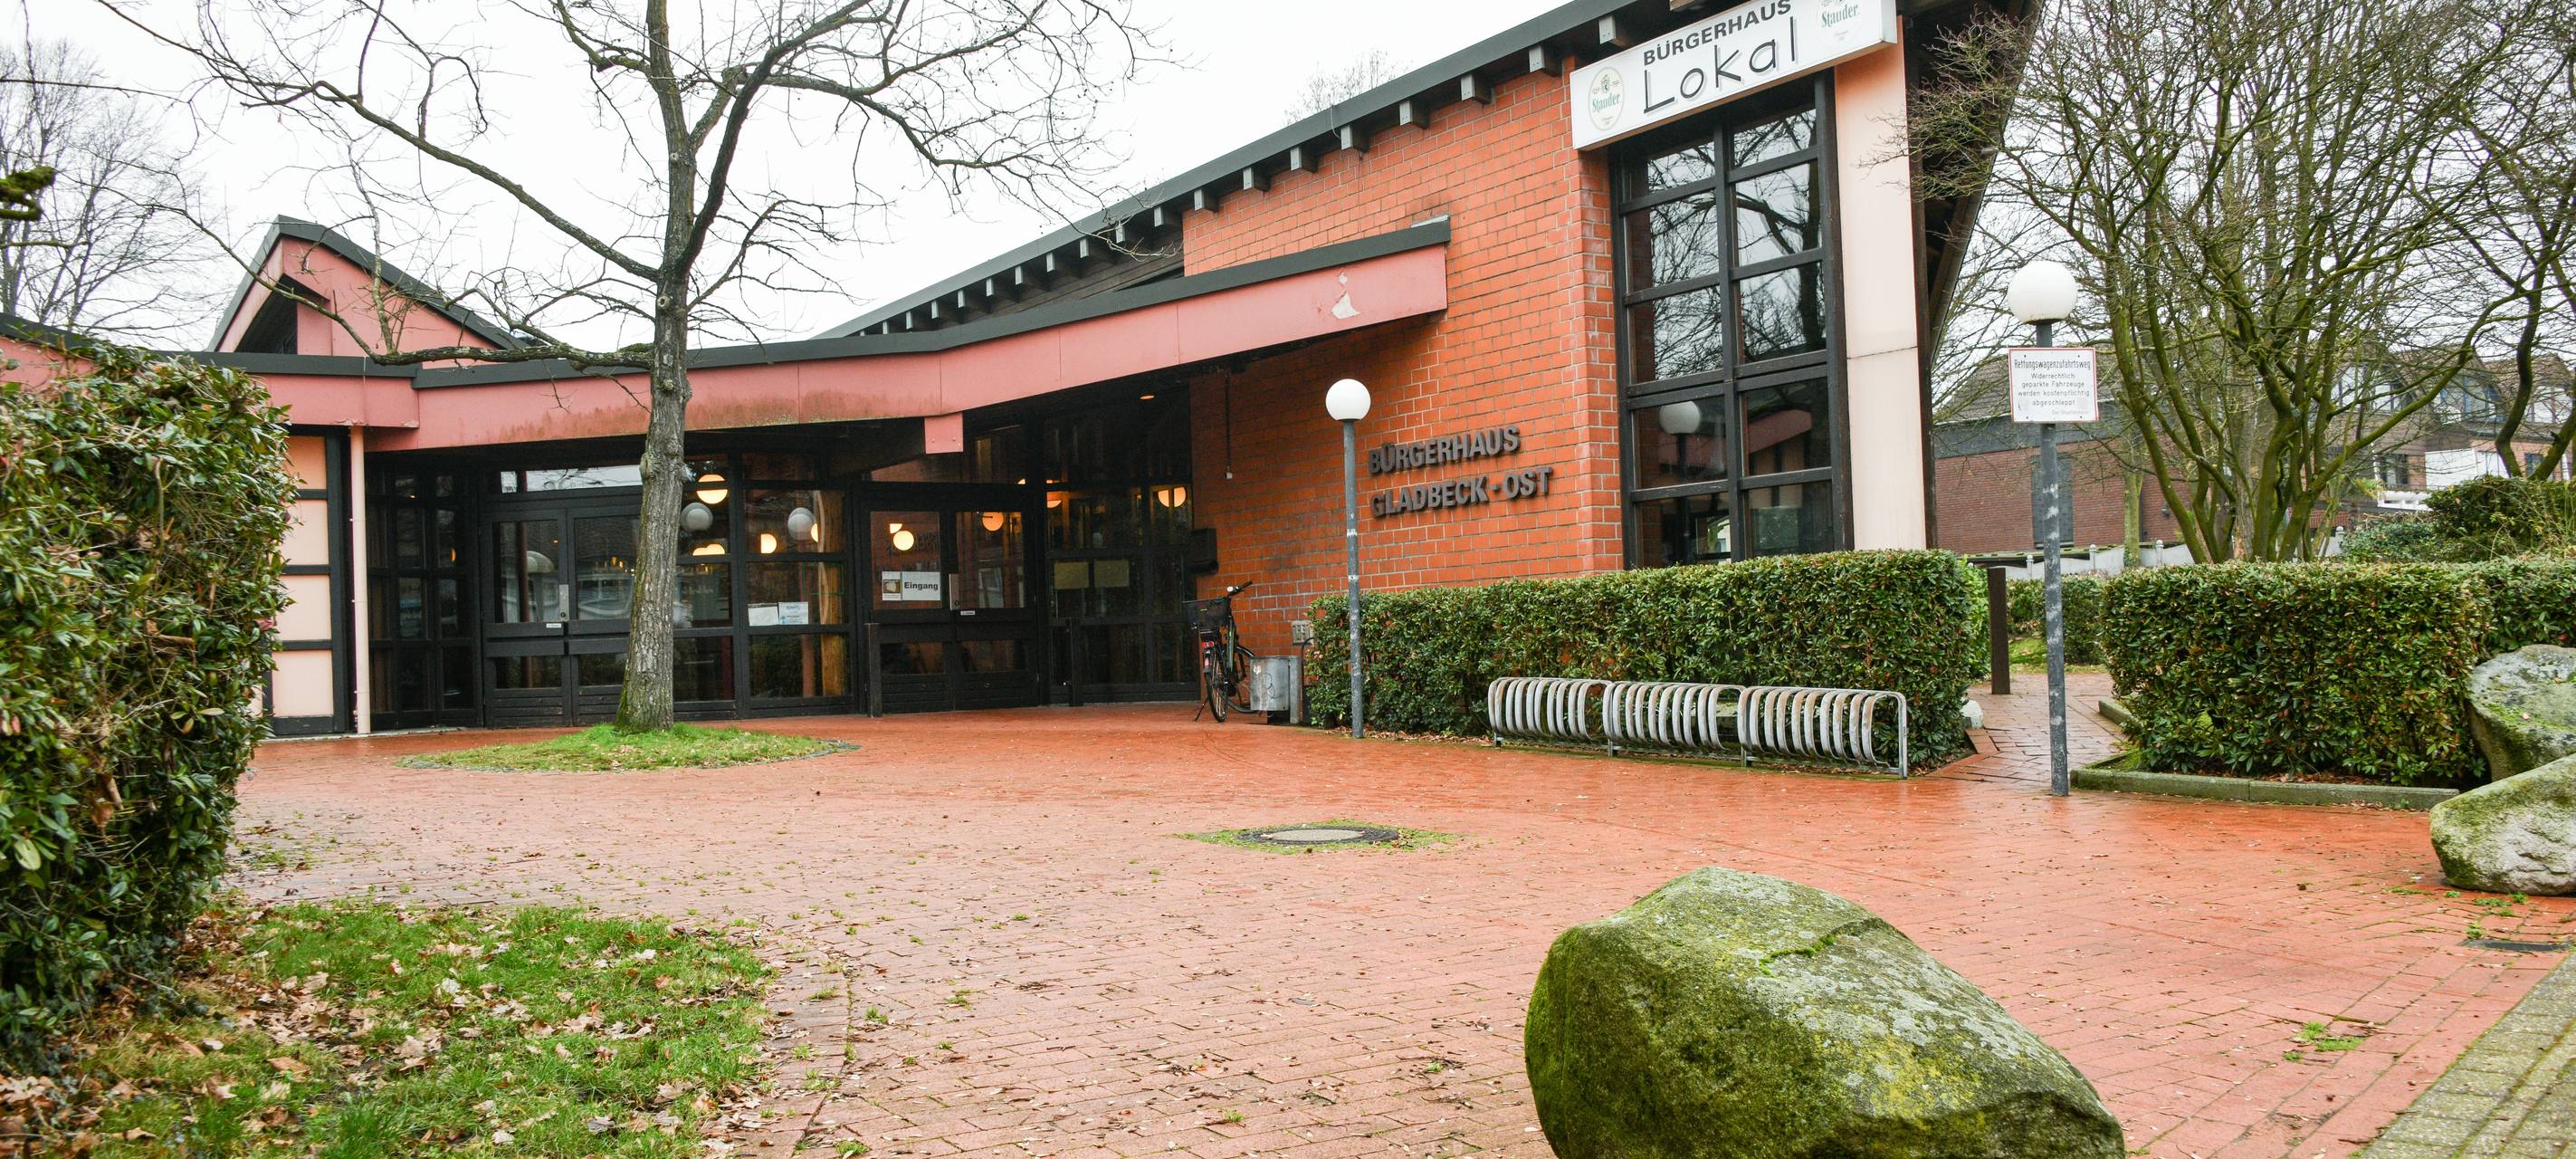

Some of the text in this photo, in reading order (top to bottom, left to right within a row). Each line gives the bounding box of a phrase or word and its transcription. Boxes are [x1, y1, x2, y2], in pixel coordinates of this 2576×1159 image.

[1821, 4, 1858, 28] Stauder
[1643, 0, 1791, 66] BÜRGERHAUS
[1643, 16, 1796, 114] Lokal
[1592, 92, 1620, 113] Stauder
[2014, 359, 2091, 370] Rettungswagenzufahrtsweg
[2021, 380, 2085, 389] geparkte Fahrzeuge
[2042, 389, 2090, 398] kostenpflichtig
[2032, 398, 2075, 407] abgeschleppt
[1369, 426, 1521, 476] BÜRGERHAUS
[903, 581, 939, 590] Eingang
